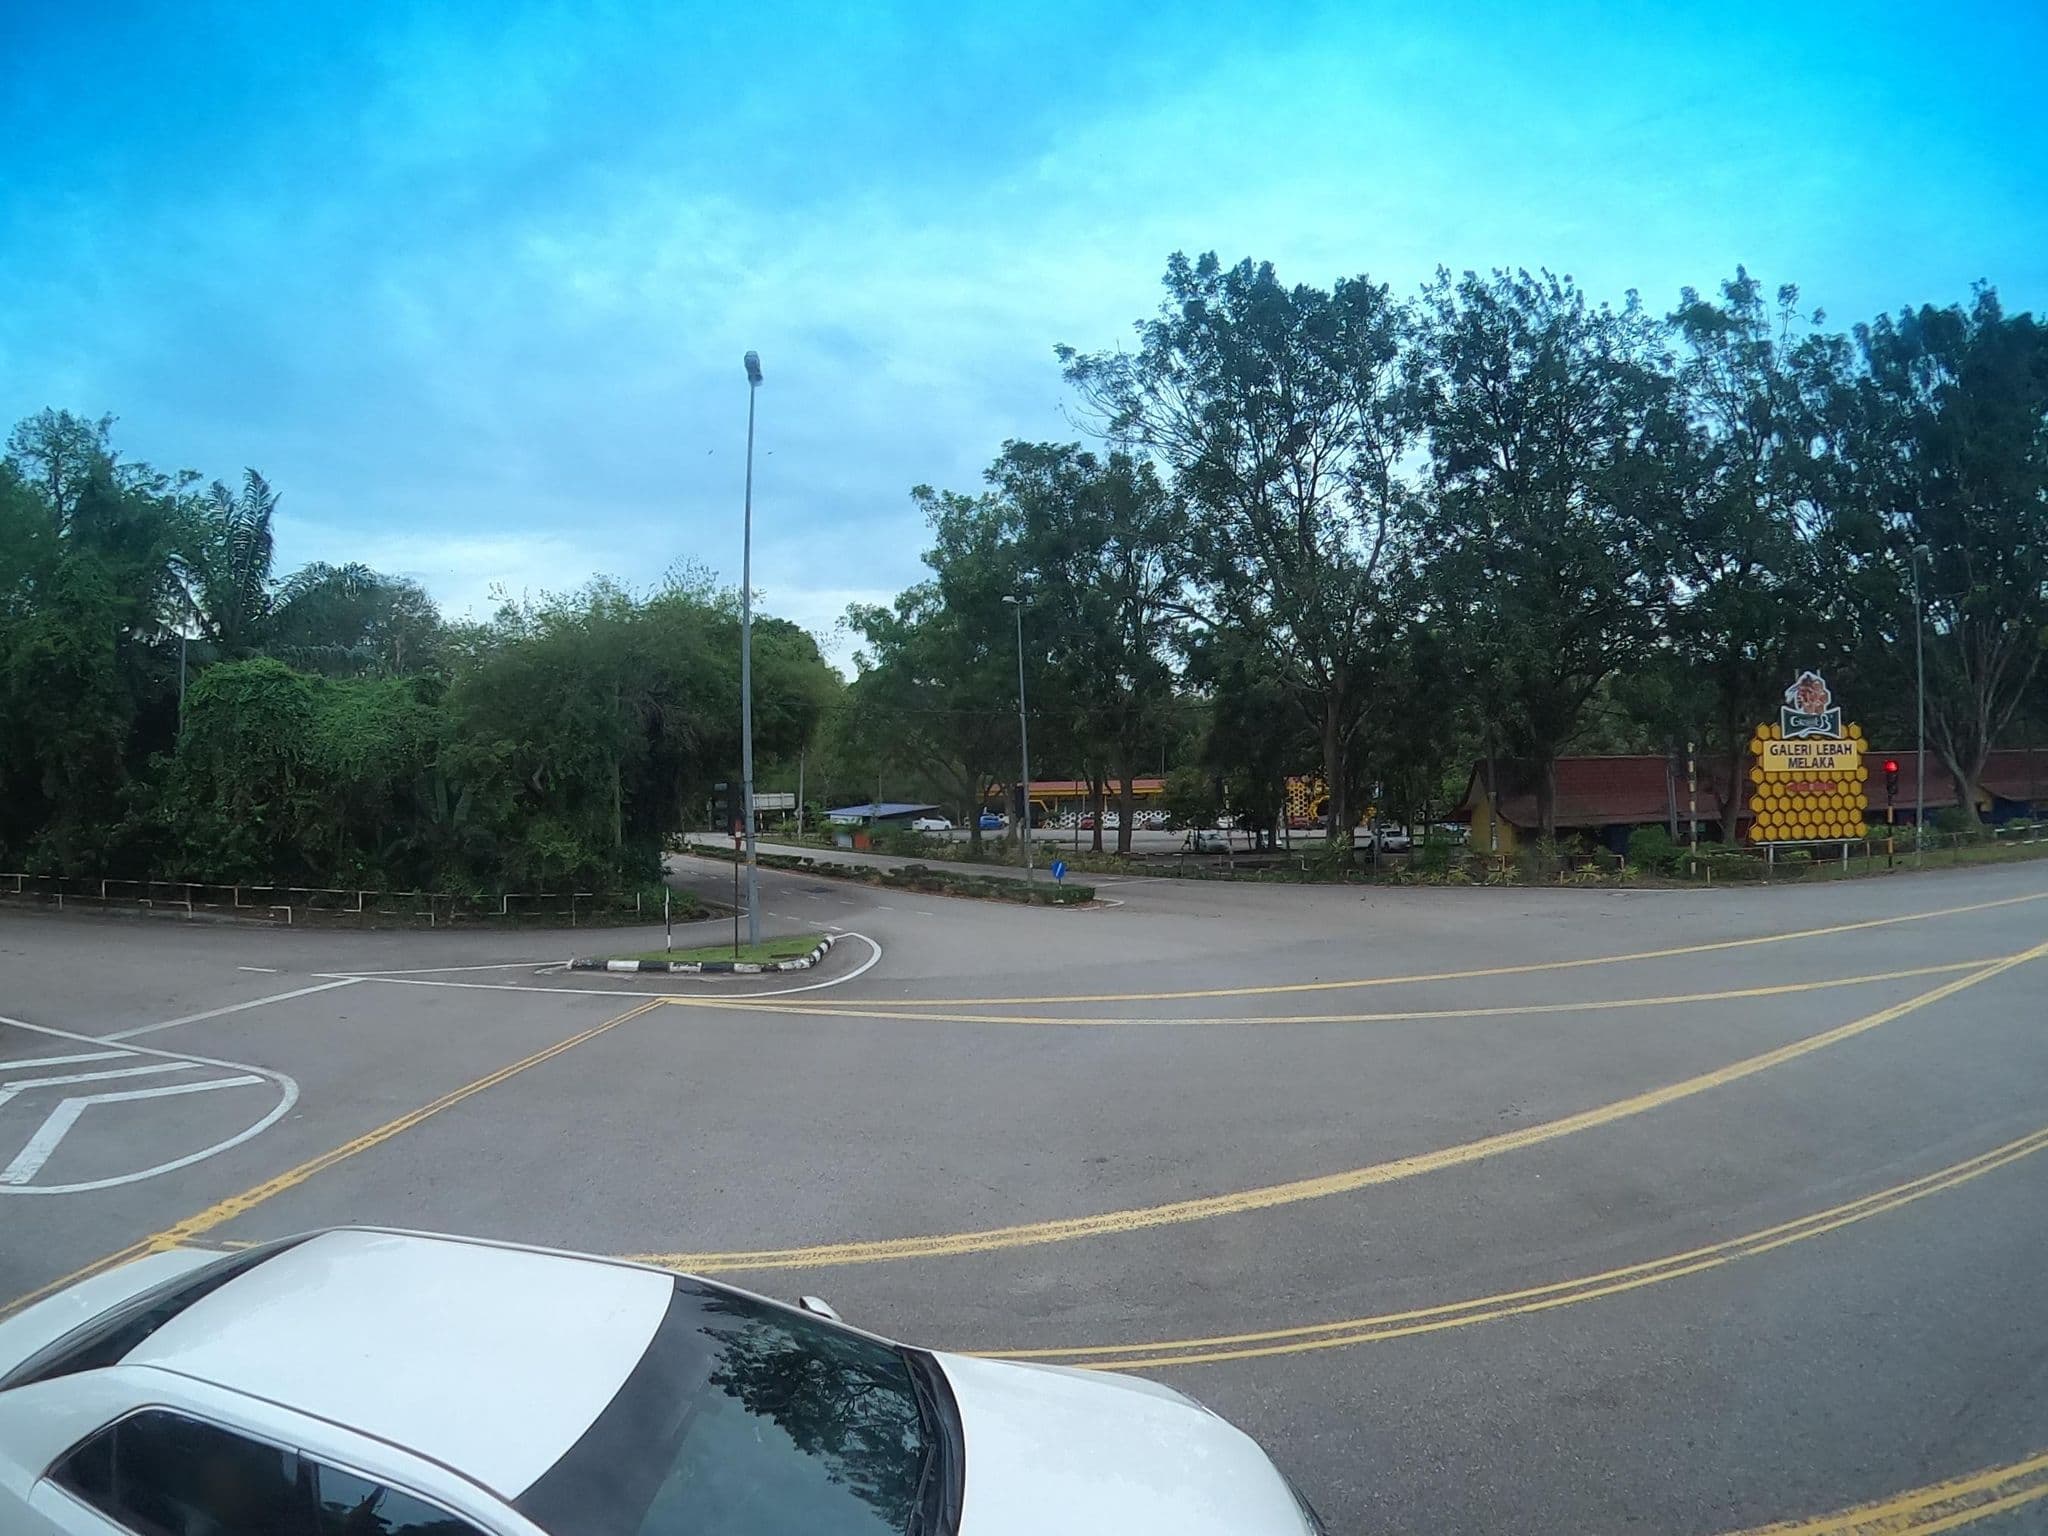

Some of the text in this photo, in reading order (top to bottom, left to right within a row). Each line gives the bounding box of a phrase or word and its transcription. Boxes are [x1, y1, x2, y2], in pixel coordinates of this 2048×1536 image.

[1770, 744, 1852, 756] GALERI LEBAH
[1788, 757, 1835, 769] MELAKA
